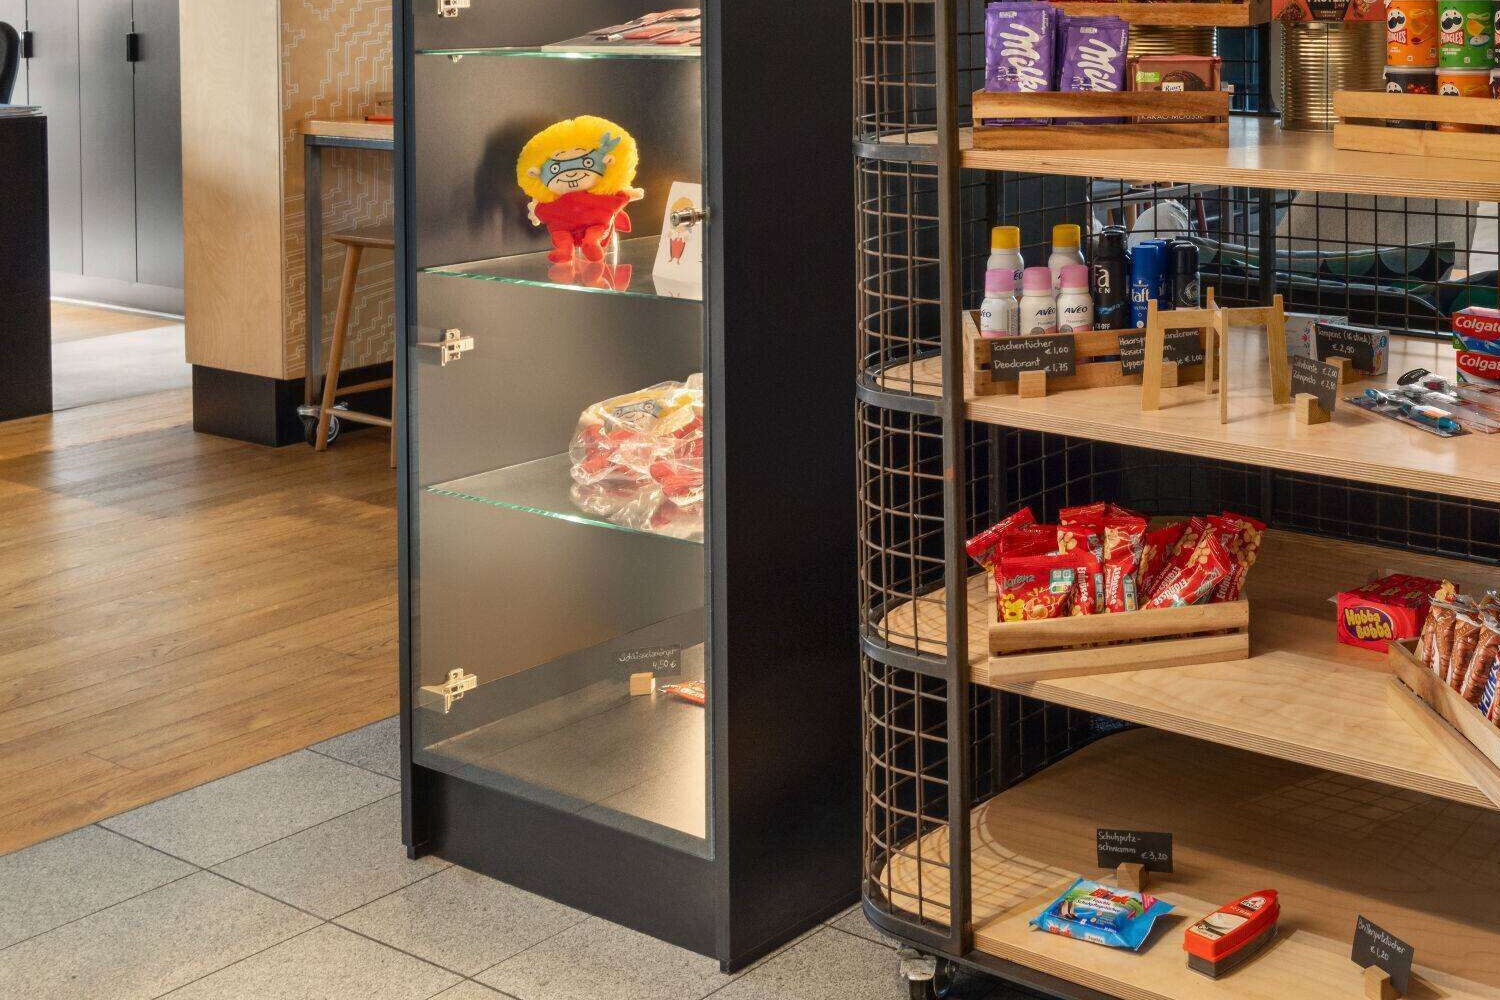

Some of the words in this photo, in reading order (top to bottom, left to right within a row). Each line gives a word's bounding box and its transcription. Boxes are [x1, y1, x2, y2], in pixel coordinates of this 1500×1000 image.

[1064, 305, 1088, 314] AVEO
[994, 357, 1040, 369] Deodorant
[1344, 608, 1381, 626] Hubba
[1355, 621, 1392, 640] Bubba
